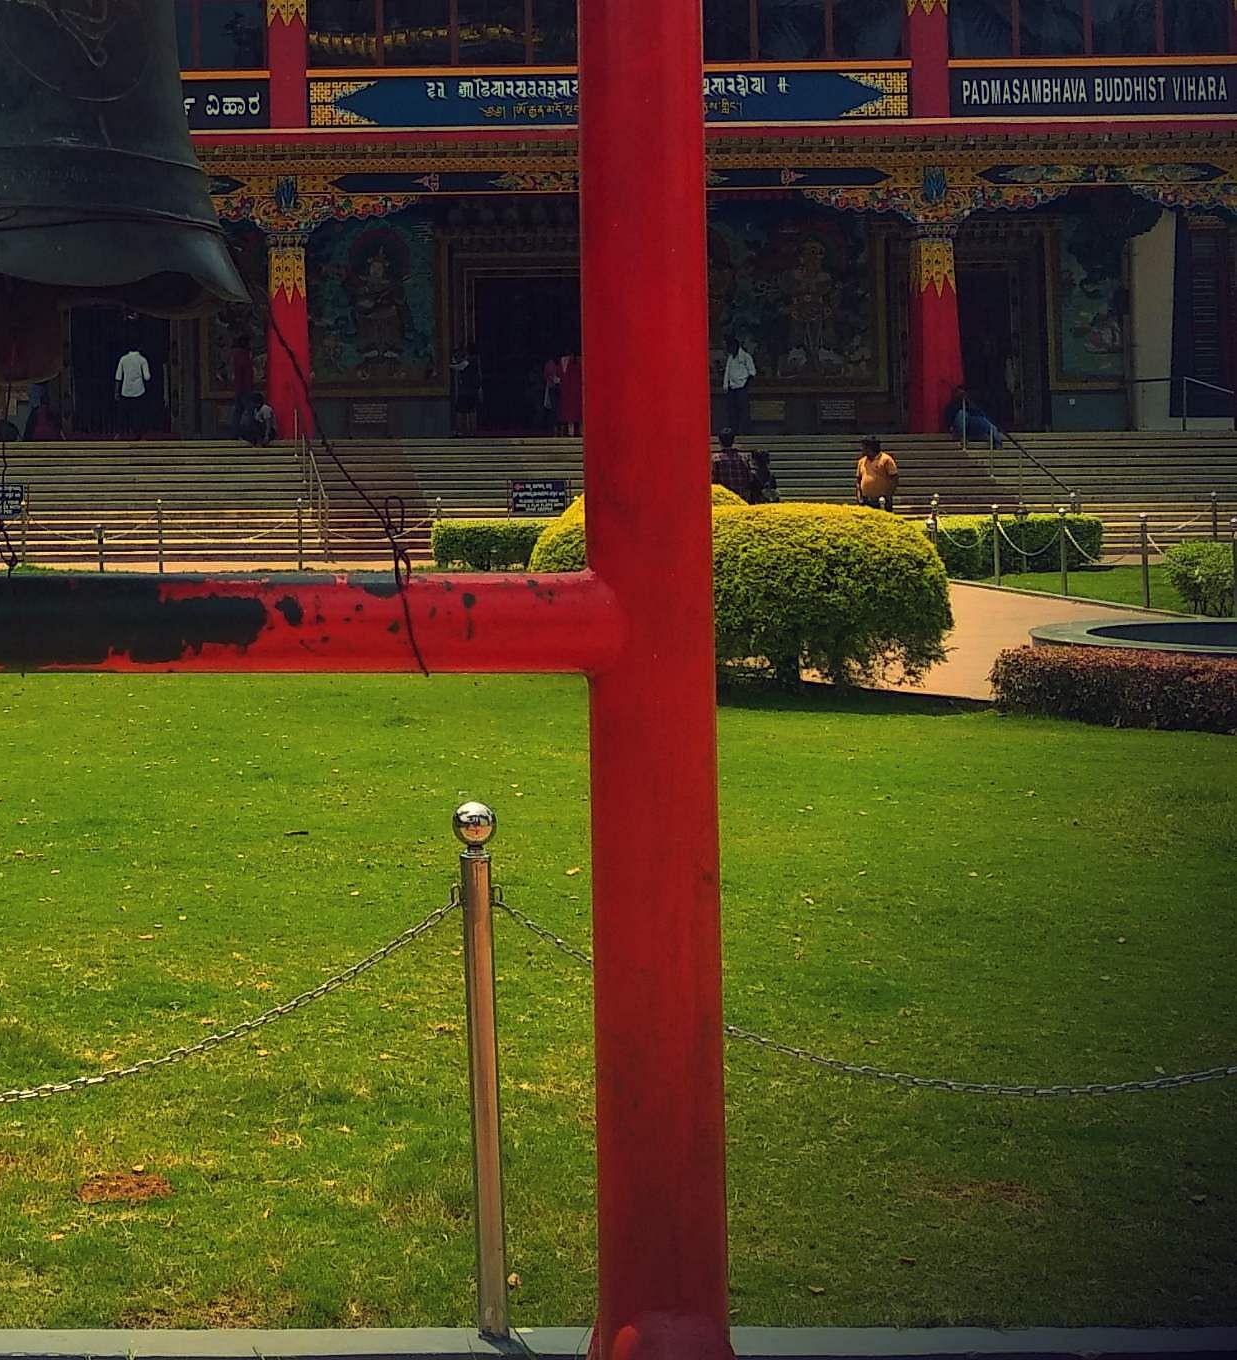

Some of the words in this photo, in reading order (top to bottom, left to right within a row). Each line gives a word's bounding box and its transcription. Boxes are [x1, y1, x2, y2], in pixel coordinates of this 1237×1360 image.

[205, 91, 261, 116] ವಿಹಾರ
[962, 78, 1088, 105] PADMASAMBHAVA
[1095, 76, 1166, 103] BUDDHIST
[1173, 75, 1228, 102] VIHARA
